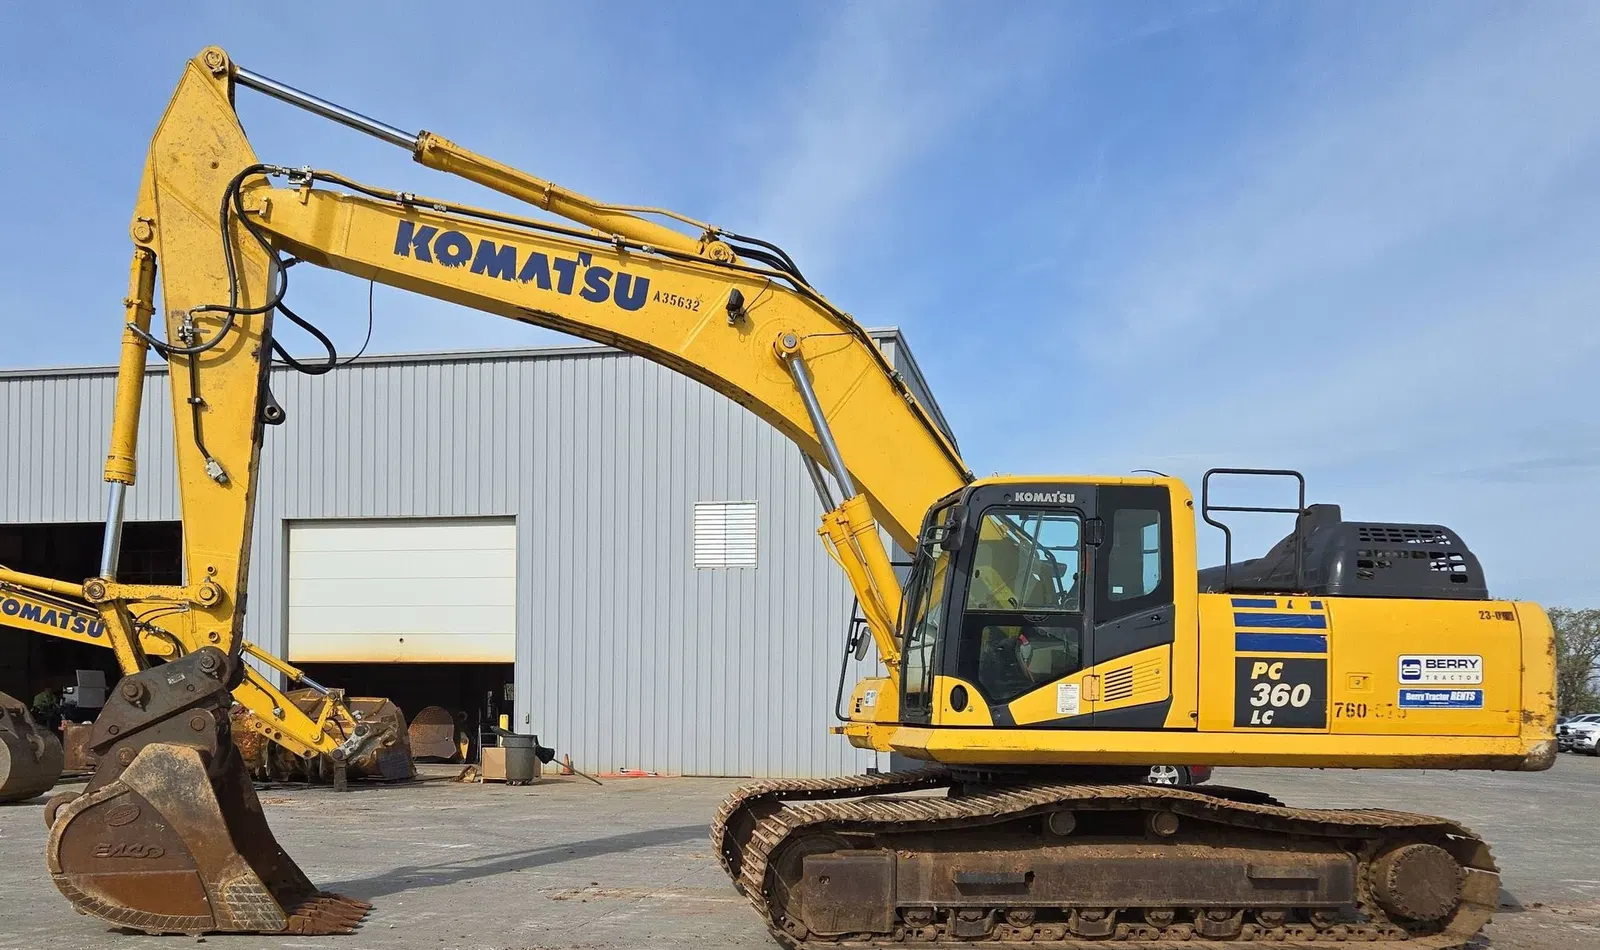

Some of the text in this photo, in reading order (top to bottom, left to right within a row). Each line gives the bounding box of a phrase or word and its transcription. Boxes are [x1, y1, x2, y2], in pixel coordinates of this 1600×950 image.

[393, 219, 650, 311] KOMATSU
[653, 290, 700, 312] A35632
[1015, 490, 1075, 504] KOMATSU
[0, 597, 106, 638] OMATSU
[1250, 661, 1284, 680] PC
[1425, 659, 1478, 668] BERRY
[1249, 682, 1312, 708] 360
[1405, 693, 1424, 701] Berry
[1425, 693, 1449, 701] Tractor
[1250, 710, 1274, 725] LC
